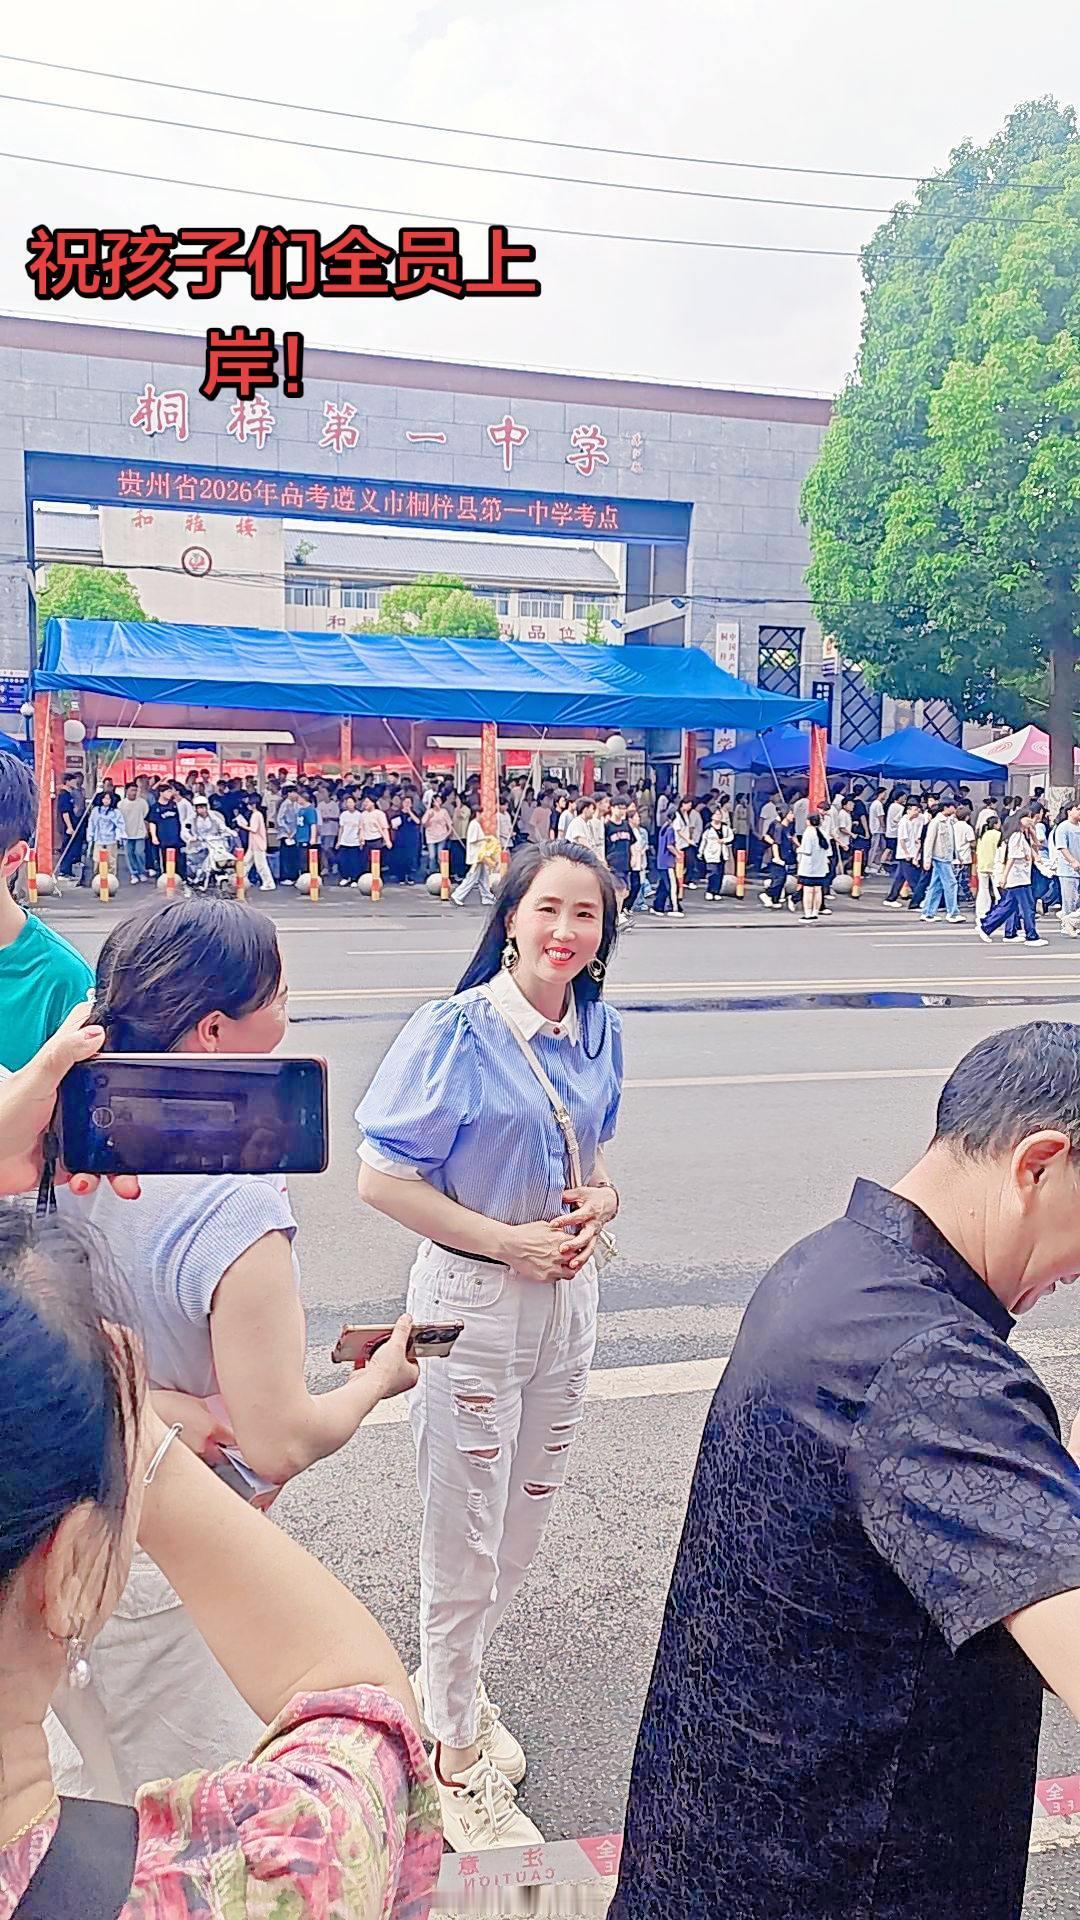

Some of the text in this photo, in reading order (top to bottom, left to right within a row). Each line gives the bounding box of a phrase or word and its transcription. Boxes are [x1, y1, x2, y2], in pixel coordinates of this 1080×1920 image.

[130, 383, 610, 476] 桐梓第一中学
[117, 468, 619, 530] 贵州省2026年高考遵义市桐梓县第一中学考点
